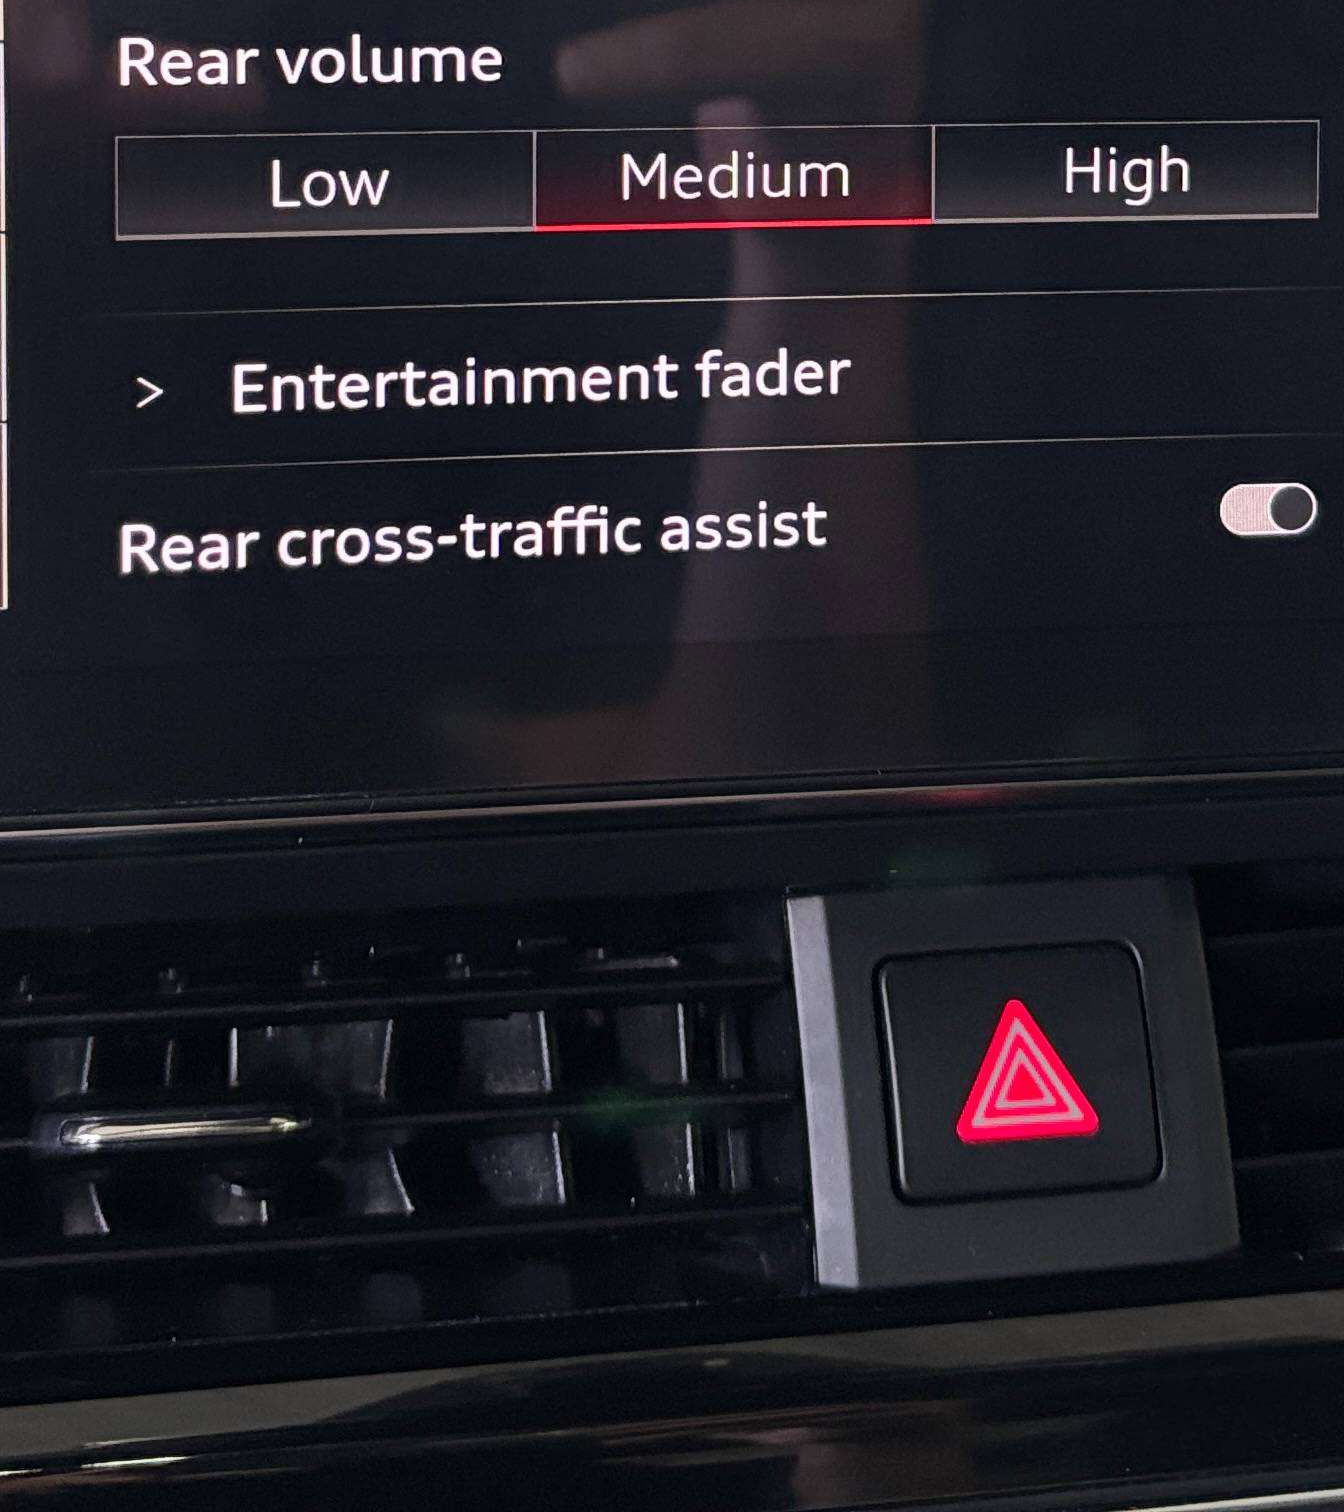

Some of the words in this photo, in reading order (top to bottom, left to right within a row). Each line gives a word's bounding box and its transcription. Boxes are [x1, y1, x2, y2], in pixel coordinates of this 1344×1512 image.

[119, 37, 260, 87] Rear
[275, 33, 504, 85] volume
[271, 159, 391, 208] Low
[622, 149, 851, 201] Medium
[1065, 144, 1191, 207] High
[233, 354, 680, 414] Entertainment
[694, 347, 852, 399] fader
[120, 523, 261, 574] Rear
[277, 502, 643, 567] cross-traffic
[660, 500, 828, 552] assist
